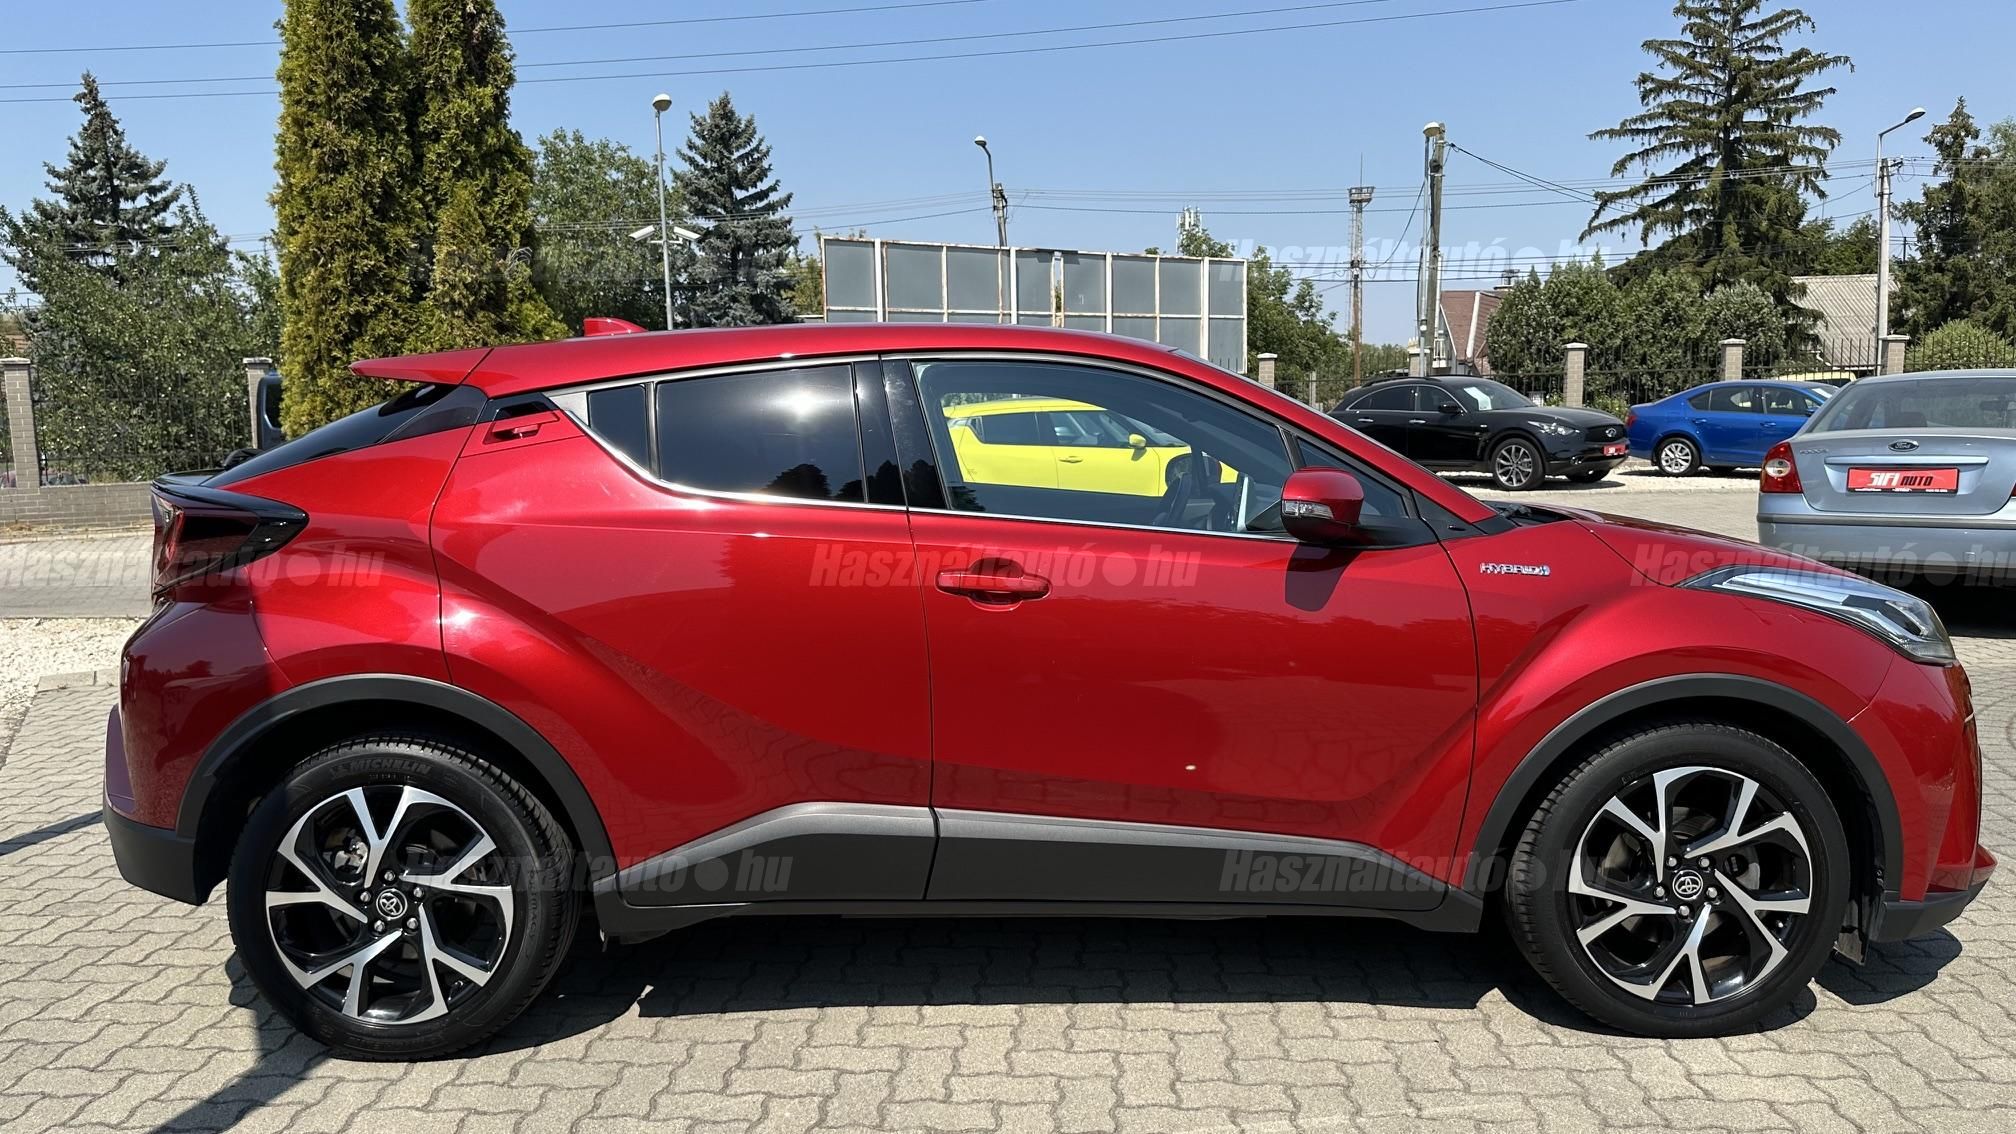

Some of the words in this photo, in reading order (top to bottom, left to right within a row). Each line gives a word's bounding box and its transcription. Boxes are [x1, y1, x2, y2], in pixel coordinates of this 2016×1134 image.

[1900, 475, 1934, 486] AUTO
[1480, 562, 1541, 576] HYBRID
[350, 757, 432, 775] MICHELIN
